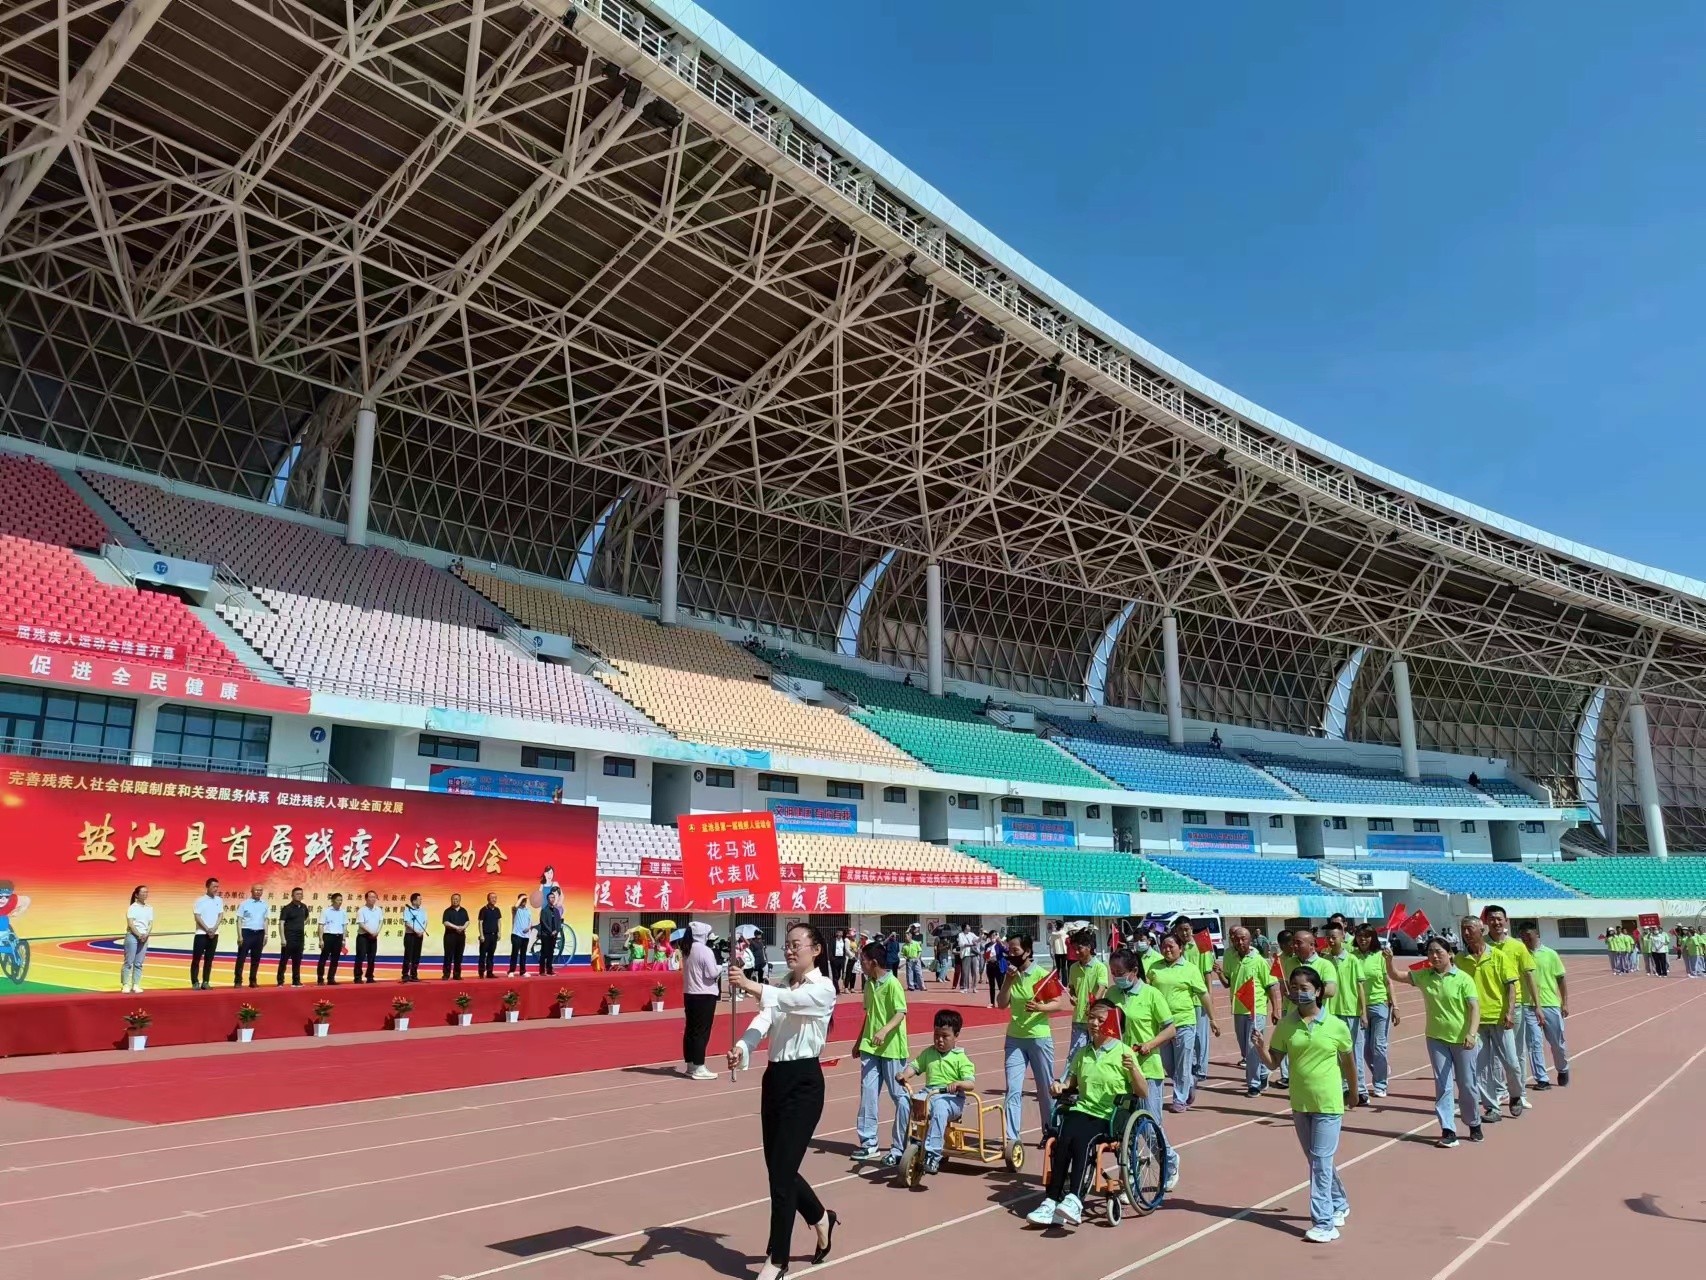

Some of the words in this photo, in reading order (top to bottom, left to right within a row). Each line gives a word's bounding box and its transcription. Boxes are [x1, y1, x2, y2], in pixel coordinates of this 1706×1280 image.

[16, 625, 175, 660] 届残疾人运动会隆重开幕
[30, 654, 239, 700] 促进全民健康
[8, 771, 270, 804] 完善残疾人社会保障制度和关爱服务体系
[276, 792, 404, 815] 促进残疾人事业全面发展
[77, 813, 508, 874] 盐池县首届残疾人运动会
[706, 840, 757, 861] 花马池
[708, 863, 759, 885] 代表队
